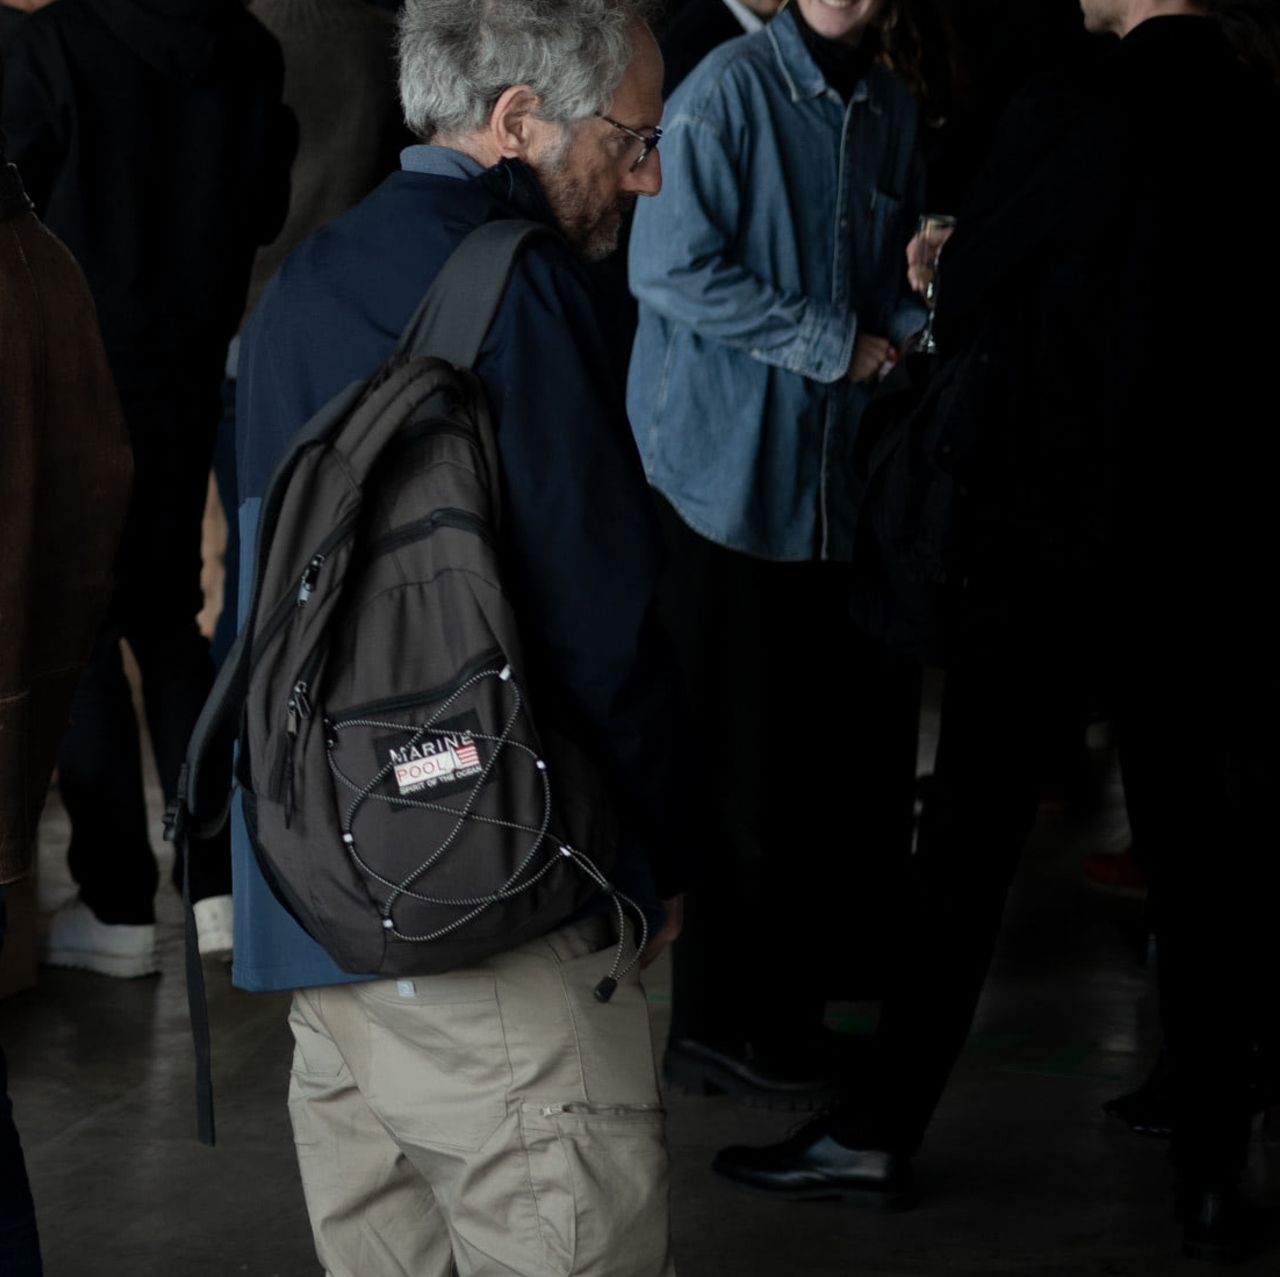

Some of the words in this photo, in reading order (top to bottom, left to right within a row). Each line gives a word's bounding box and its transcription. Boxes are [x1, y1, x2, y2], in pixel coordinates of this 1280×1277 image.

[389, 732, 474, 764] MARINE
[396, 759, 446, 782] POOL
[399, 783, 425, 795] SPIRIT
[427, 779, 438, 787] OF
[439, 773, 455, 783] THE
[456, 765, 483, 779] OCEAN
